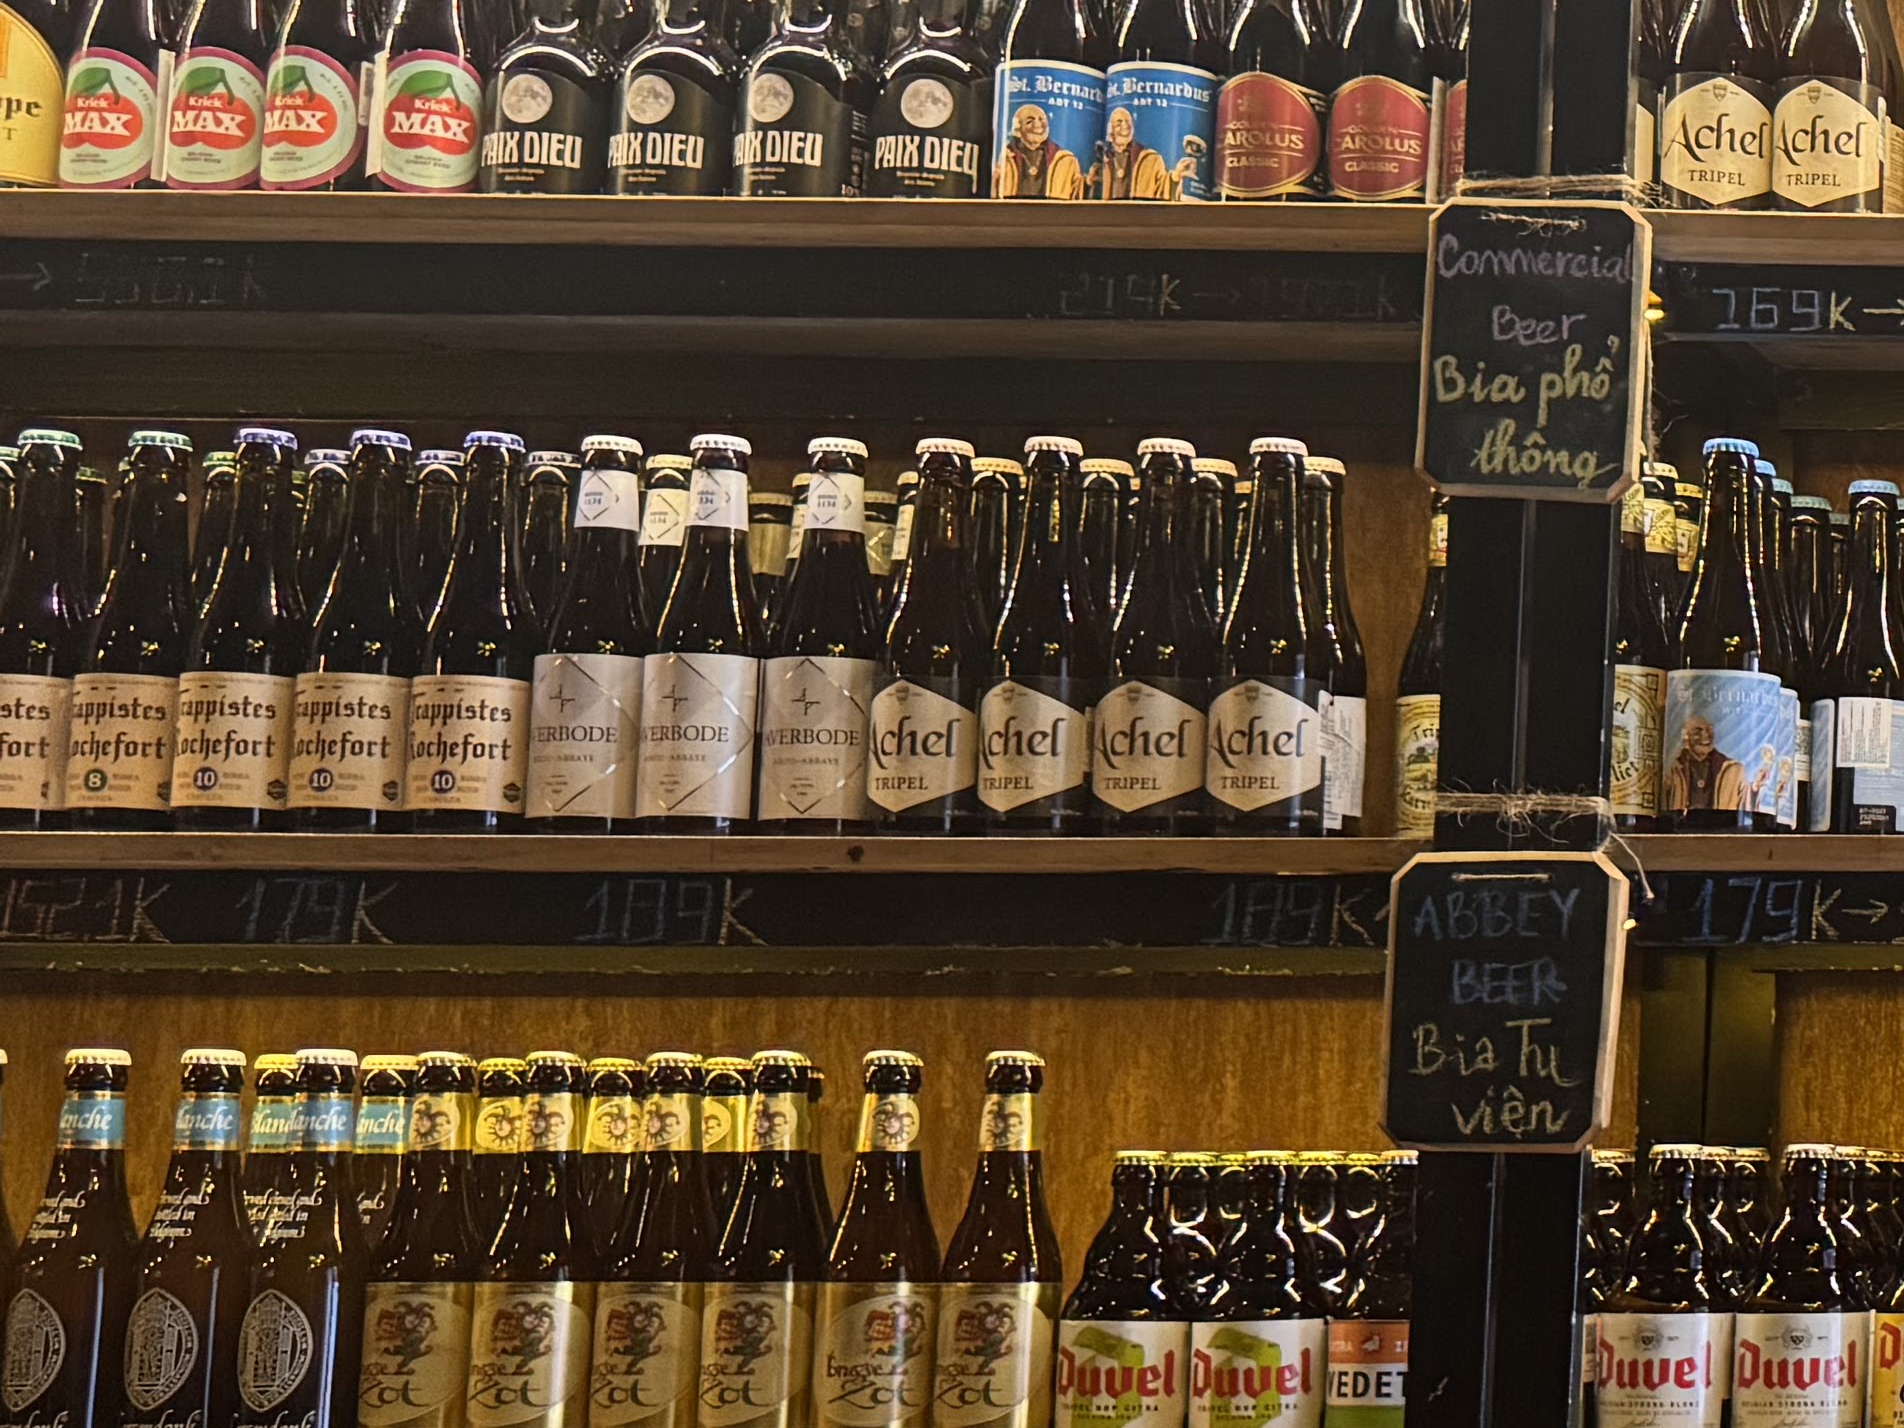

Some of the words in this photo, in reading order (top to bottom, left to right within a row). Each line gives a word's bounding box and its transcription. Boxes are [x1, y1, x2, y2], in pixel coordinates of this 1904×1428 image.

[392, 111, 473, 144] MAX
[1664, 112, 1769, 160] Achel
[876, 134, 919, 169] PAIX
[923, 138, 979, 174] DIEU
[1688, 170, 1746, 187] TRIPEL
[1492, 306, 1586, 347] Beer
[1434, 356, 1526, 403] Bia
[1207, 713, 1310, 761] Achel
[432, 773, 453, 791] 10
[1221, 776, 1280, 793] TRIPEL
[1412, 886, 1583, 942] ABBEY
[1451, 959, 1568, 1006] BEER
[1408, 1021, 1496, 1079] Bia
[1192, 1348, 1312, 1398] Duvel
[1738, 1339, 1858, 1391] Duvel
